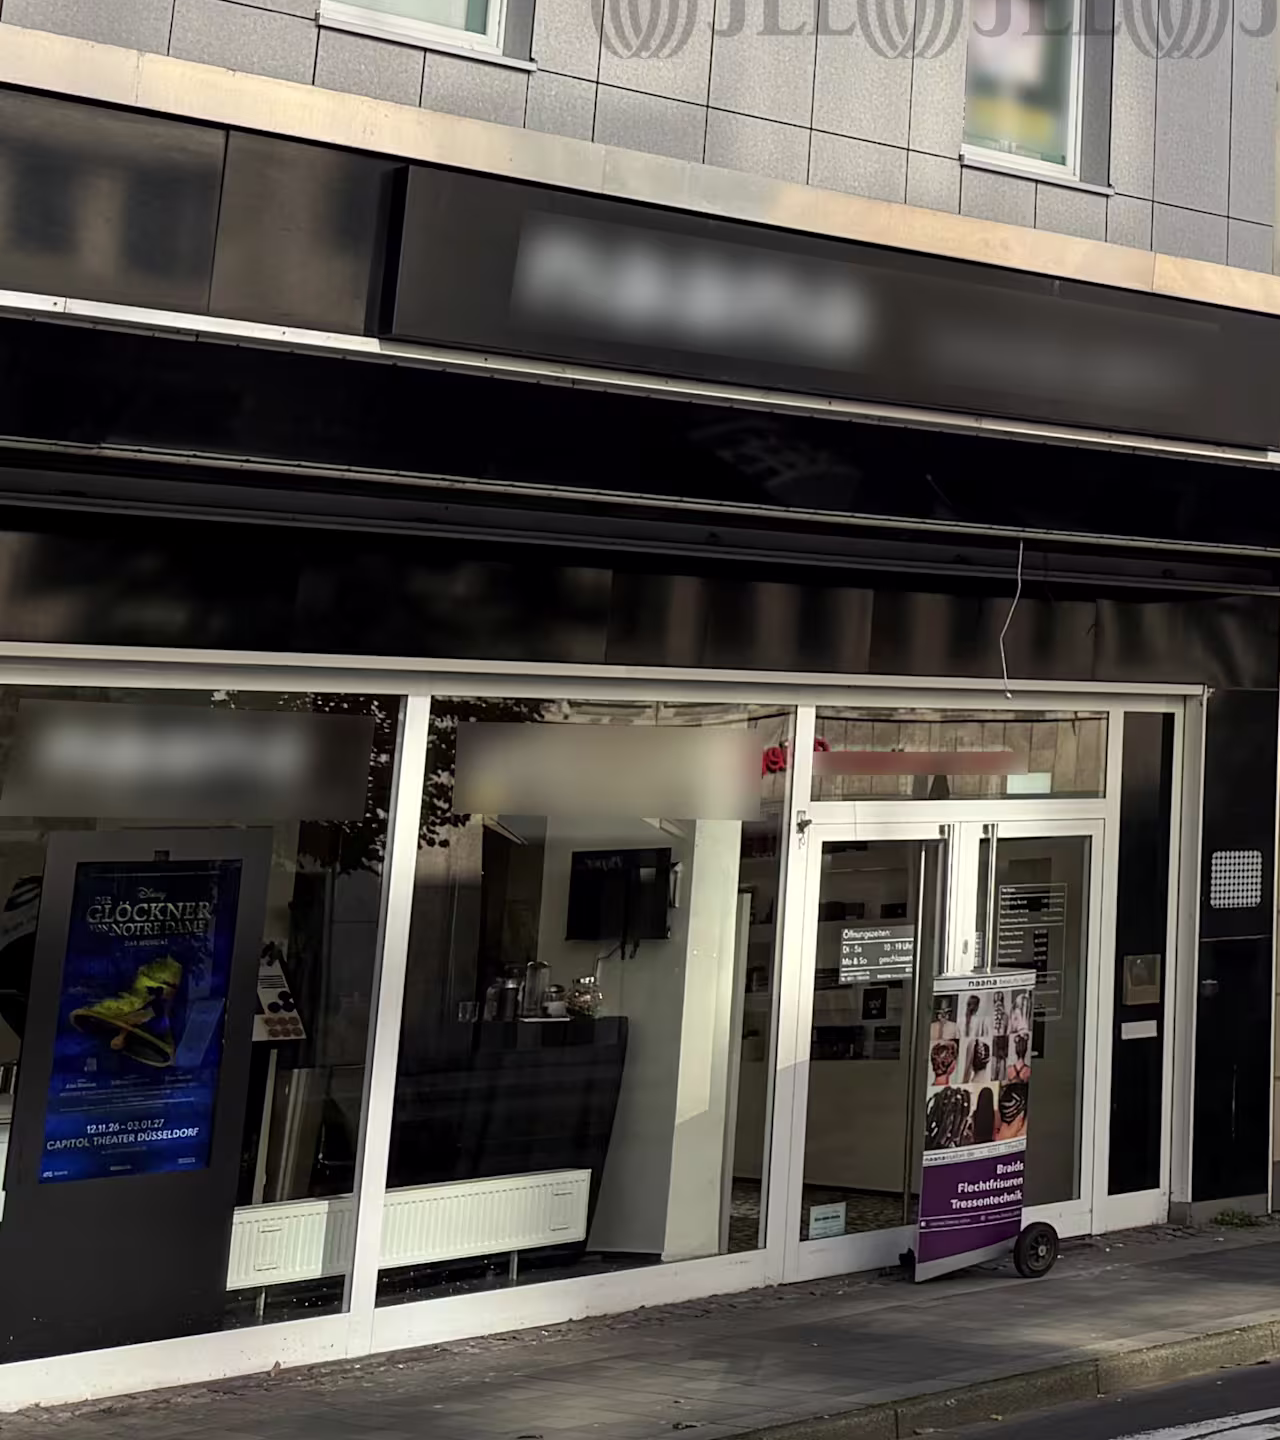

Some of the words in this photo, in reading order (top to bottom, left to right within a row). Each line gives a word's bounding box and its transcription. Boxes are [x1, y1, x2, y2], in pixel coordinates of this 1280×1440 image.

[86, 900, 213, 923] GLÖCKNER
[109, 922, 162, 937] NOTRE
[165, 920, 207, 935] DAME
[968, 979, 998, 988] naana
[86, 1122, 120, 1135] 12.11.26
[127, 1118, 165, 1131] 03.01.27
[46, 1137, 90, 1151] CAPITOL
[93, 1132, 136, 1147] THEATER
[137, 1127, 200, 1142] DÜSSELDORF
[996, 1161, 1024, 1174] Braids
[957, 1177, 1023, 1193] Flechtfrisuren
[950, 1190, 1023, 1210] Tressentechnik
